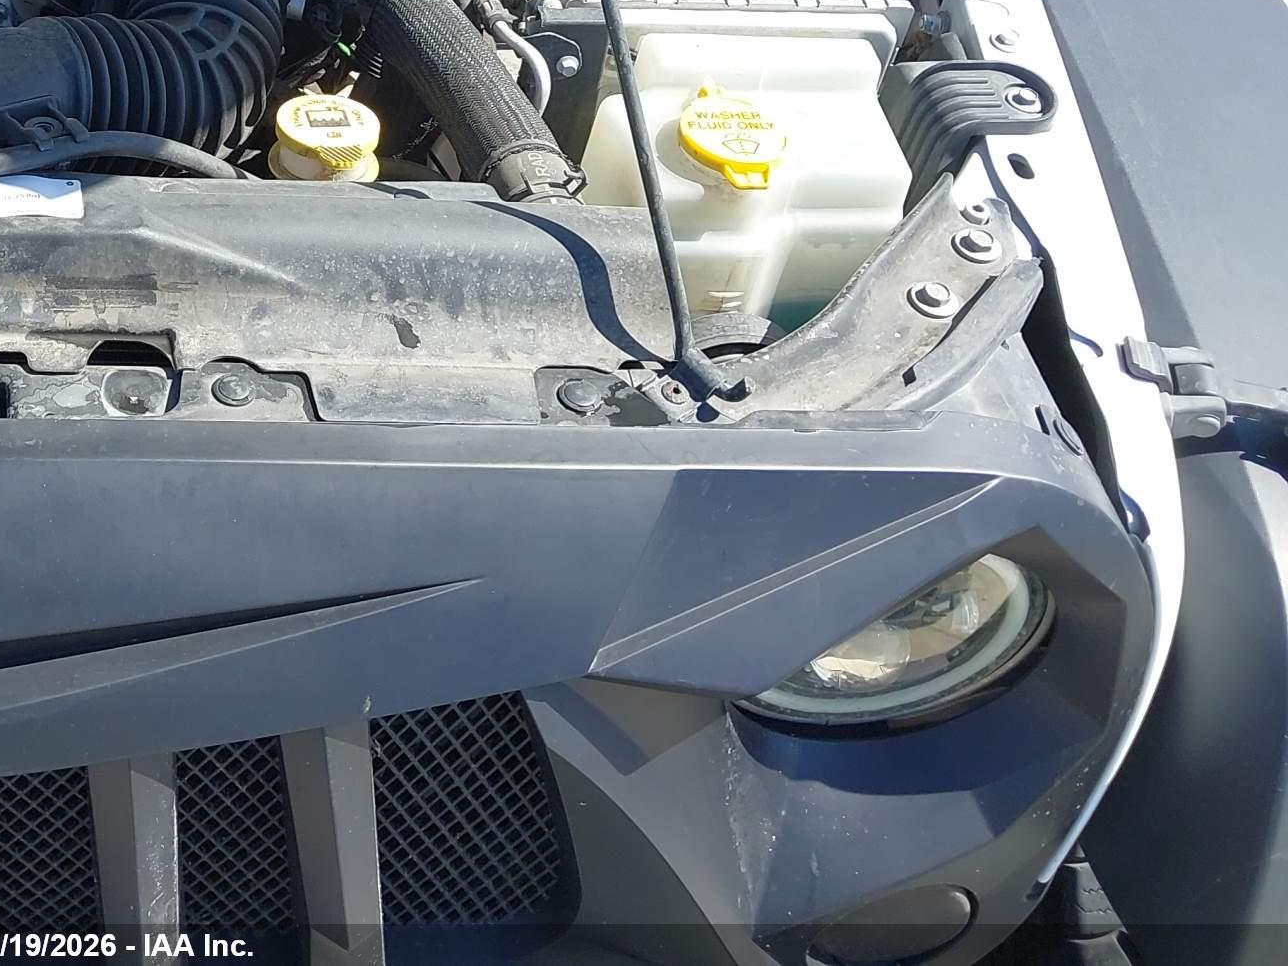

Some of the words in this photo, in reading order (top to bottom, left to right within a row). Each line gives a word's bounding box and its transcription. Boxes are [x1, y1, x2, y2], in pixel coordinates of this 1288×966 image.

[694, 111, 761, 120] WASHER
[687, 121, 732, 130] FLUID
[736, 121, 774, 130] ONLY
[527, 152, 552, 178] RAD
